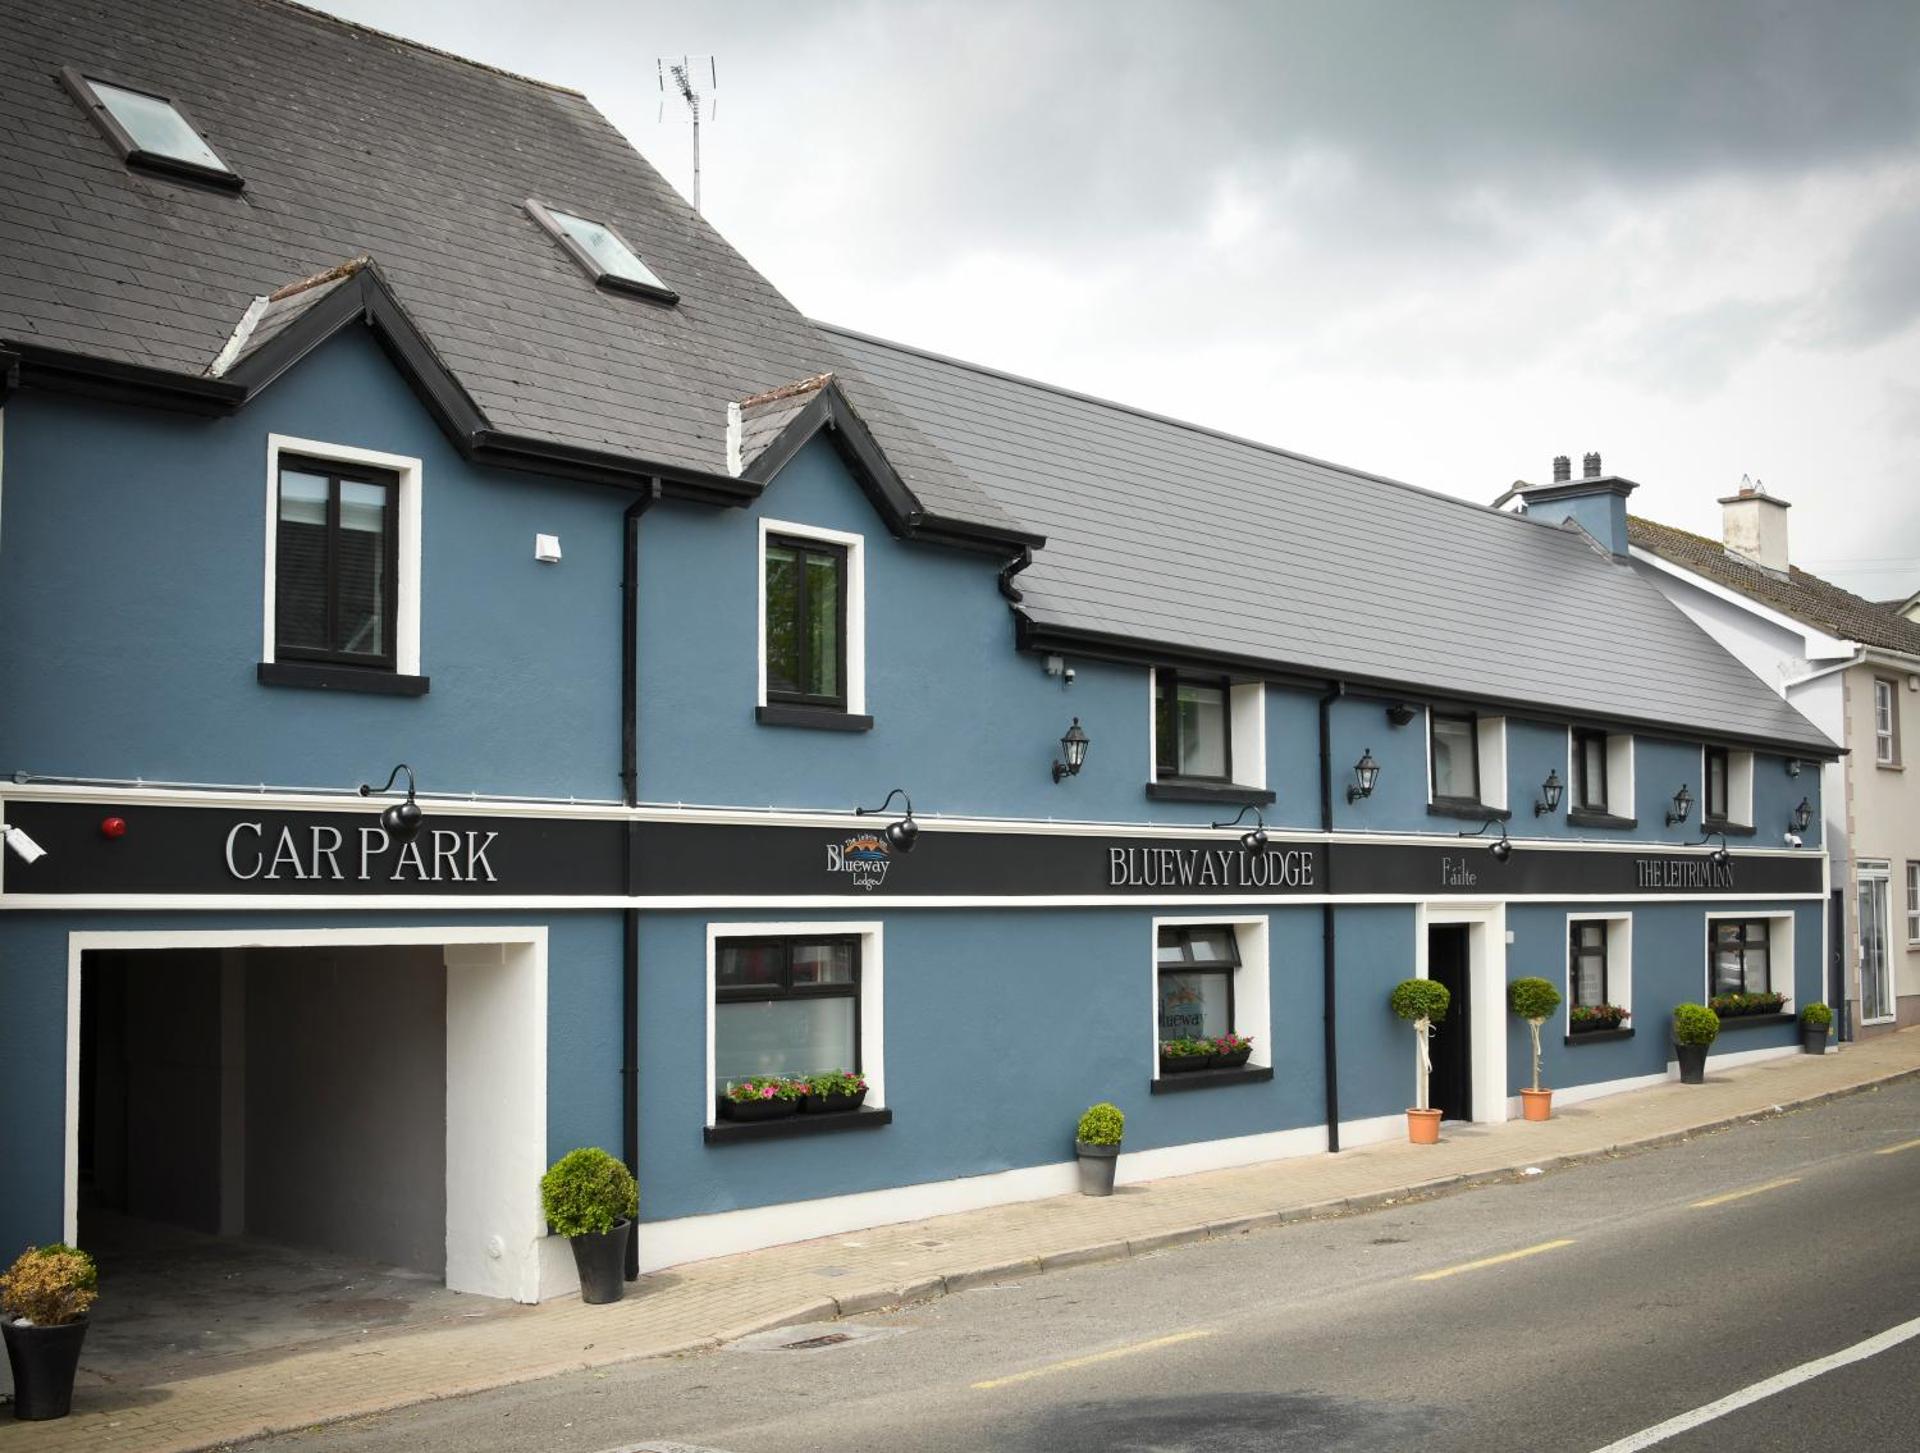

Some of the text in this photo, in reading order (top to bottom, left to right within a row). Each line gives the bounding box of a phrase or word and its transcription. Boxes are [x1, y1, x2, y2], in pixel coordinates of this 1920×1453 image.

[225, 822, 498, 882] CAR PARK
[826, 844, 890, 874] Blueway
[1110, 847, 1314, 887] BLUEWAY LODGE
[1442, 857, 1477, 886] Fáilte
[1636, 860, 1734, 888] THE LEITRIM INN
[853, 873, 881, 891] Lodge
[1158, 999, 1207, 1028] lueway
